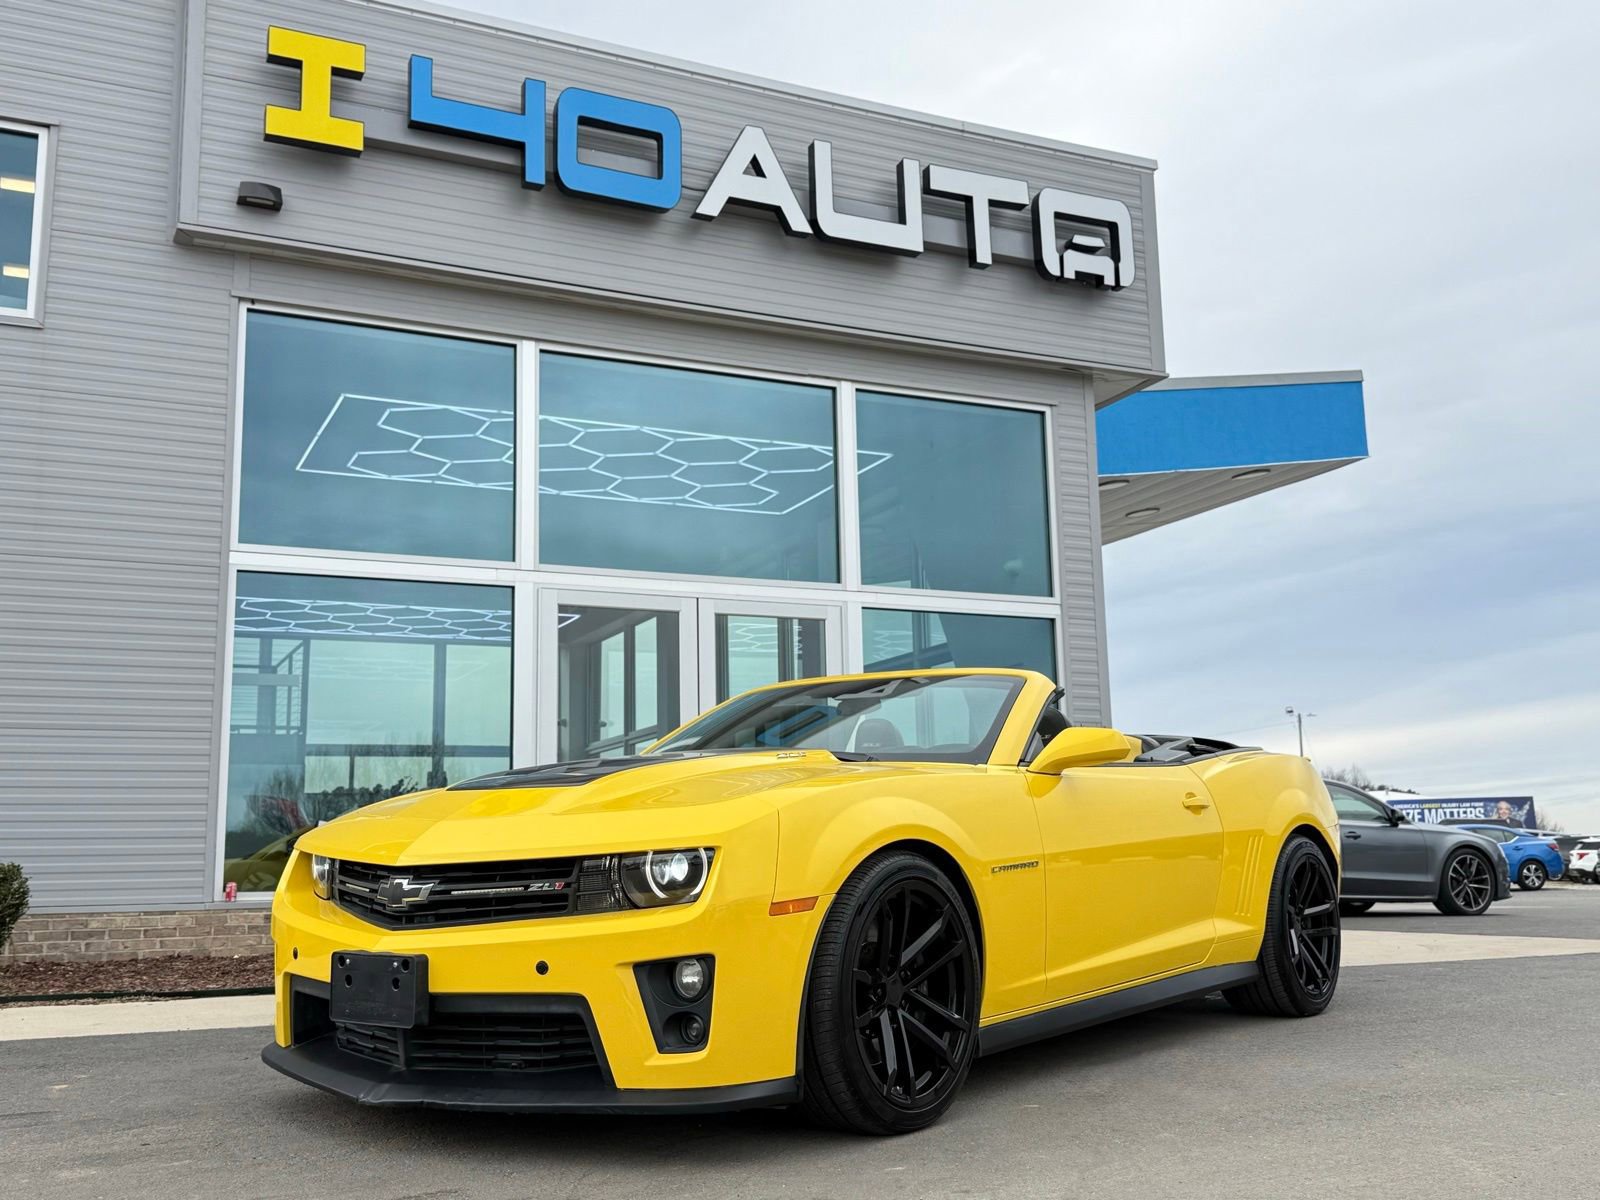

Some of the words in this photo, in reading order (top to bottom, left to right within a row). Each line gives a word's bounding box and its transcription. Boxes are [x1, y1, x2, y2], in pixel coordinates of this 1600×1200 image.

[263, 24, 366, 156] I
[1424, 807, 1485, 824] MATTERS
[991, 860, 1039, 873] CAMARO
[527, 882, 565, 892] ZL1
